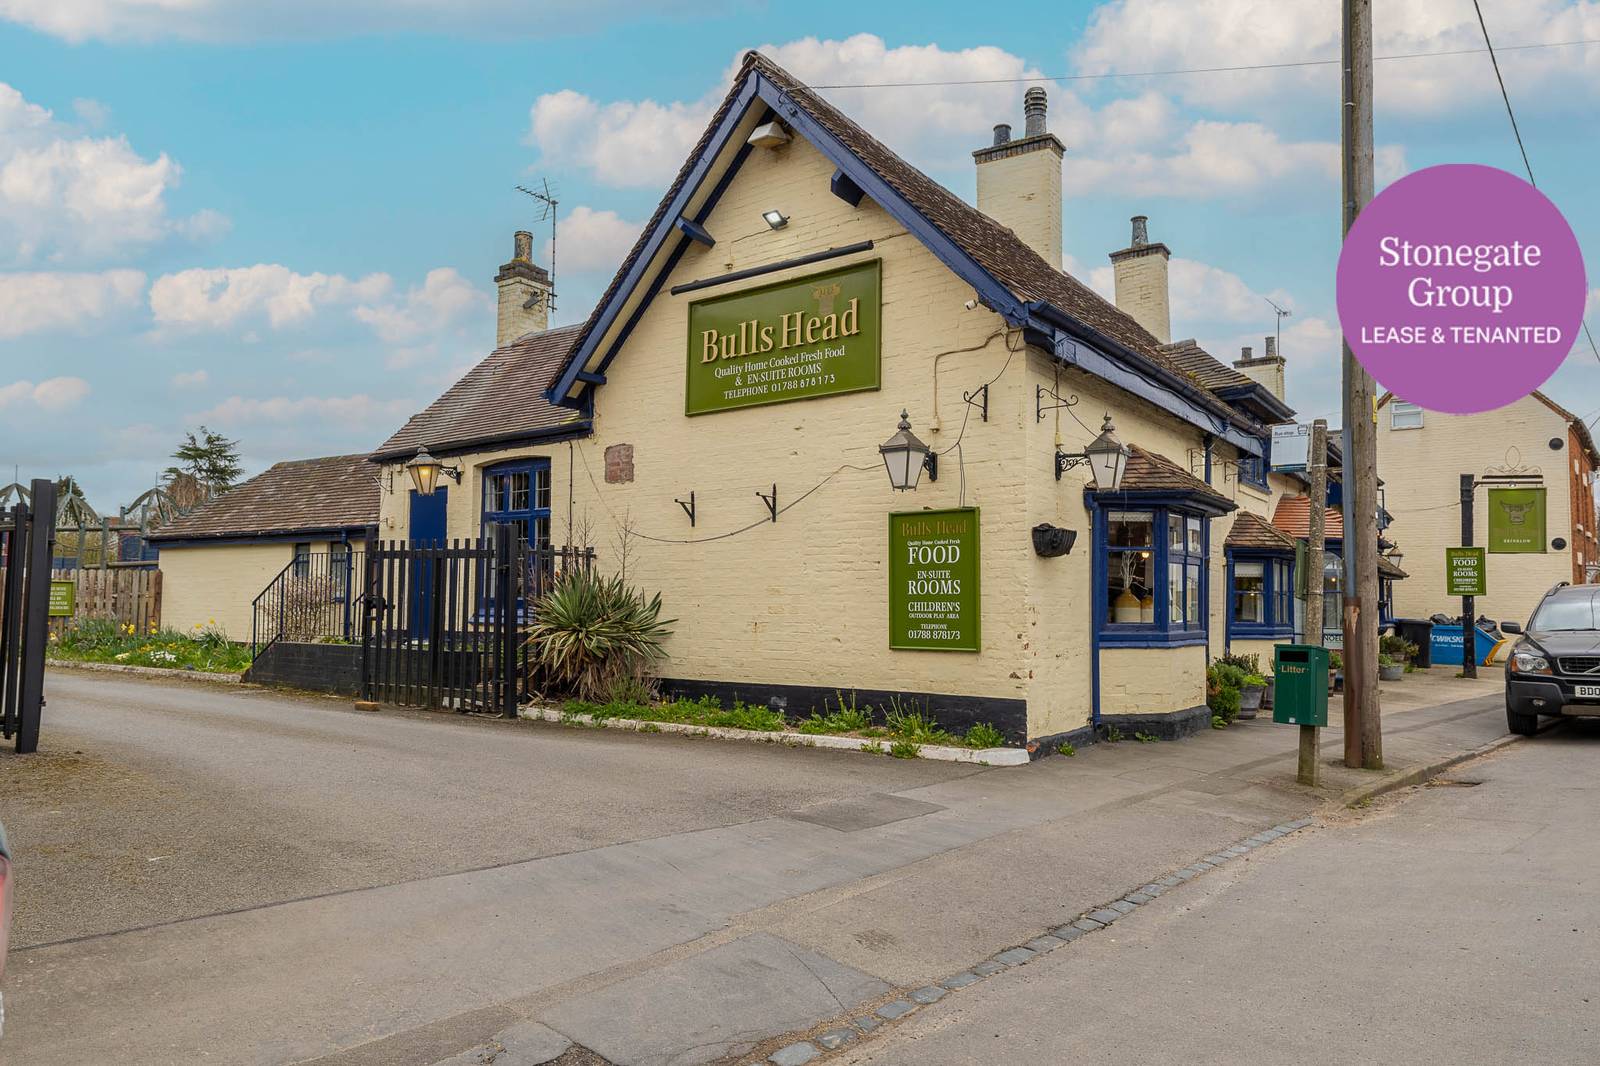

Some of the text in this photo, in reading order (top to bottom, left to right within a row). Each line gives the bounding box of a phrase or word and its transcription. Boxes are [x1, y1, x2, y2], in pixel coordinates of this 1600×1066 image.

[700, 297, 860, 364] Bulls Head
[714, 345, 845, 379] Quality Home Cooked Fresh Food
[735, 376, 743, 386] &
[788, 362, 822, 378] ROOMS
[723, 384, 769, 400] TELEPHONE
[771, 379, 798, 393] 01788
[902, 520, 967, 537] Bulls Head
[907, 545, 960, 565] FOOD
[1453, 559, 1478, 567] FOOD
[917, 570, 951, 579] EN-SUITE
[907, 580, 961, 595] ROOMS
[908, 601, 961, 612] CHILDREN'S
[908, 630, 961, 640] 01788 878173
[1281, 664, 1305, 673] Litter
